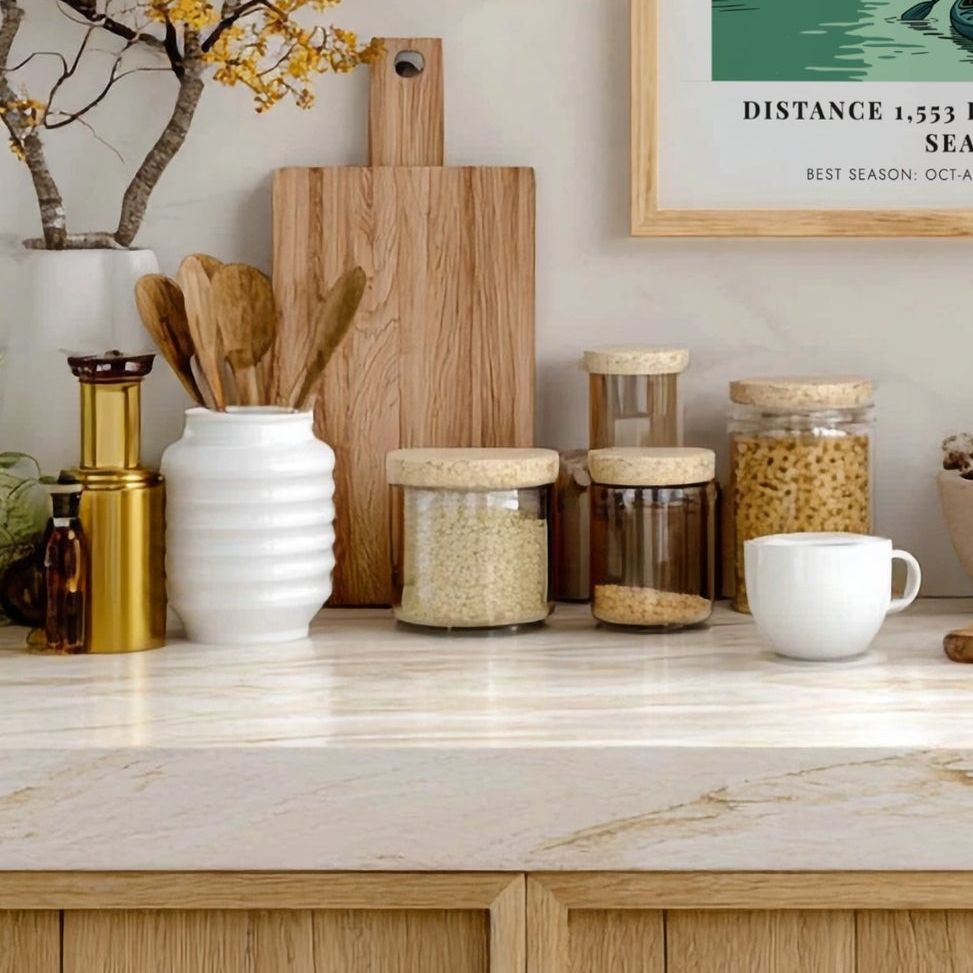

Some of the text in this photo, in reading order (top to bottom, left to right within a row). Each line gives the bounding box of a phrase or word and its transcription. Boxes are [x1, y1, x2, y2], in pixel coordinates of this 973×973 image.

[743, 101, 883, 121] DISTANCE
[895, 105, 956, 125] 1,553
[806, 167, 842, 181] BEST
[848, 167, 918, 181] SEASON:
